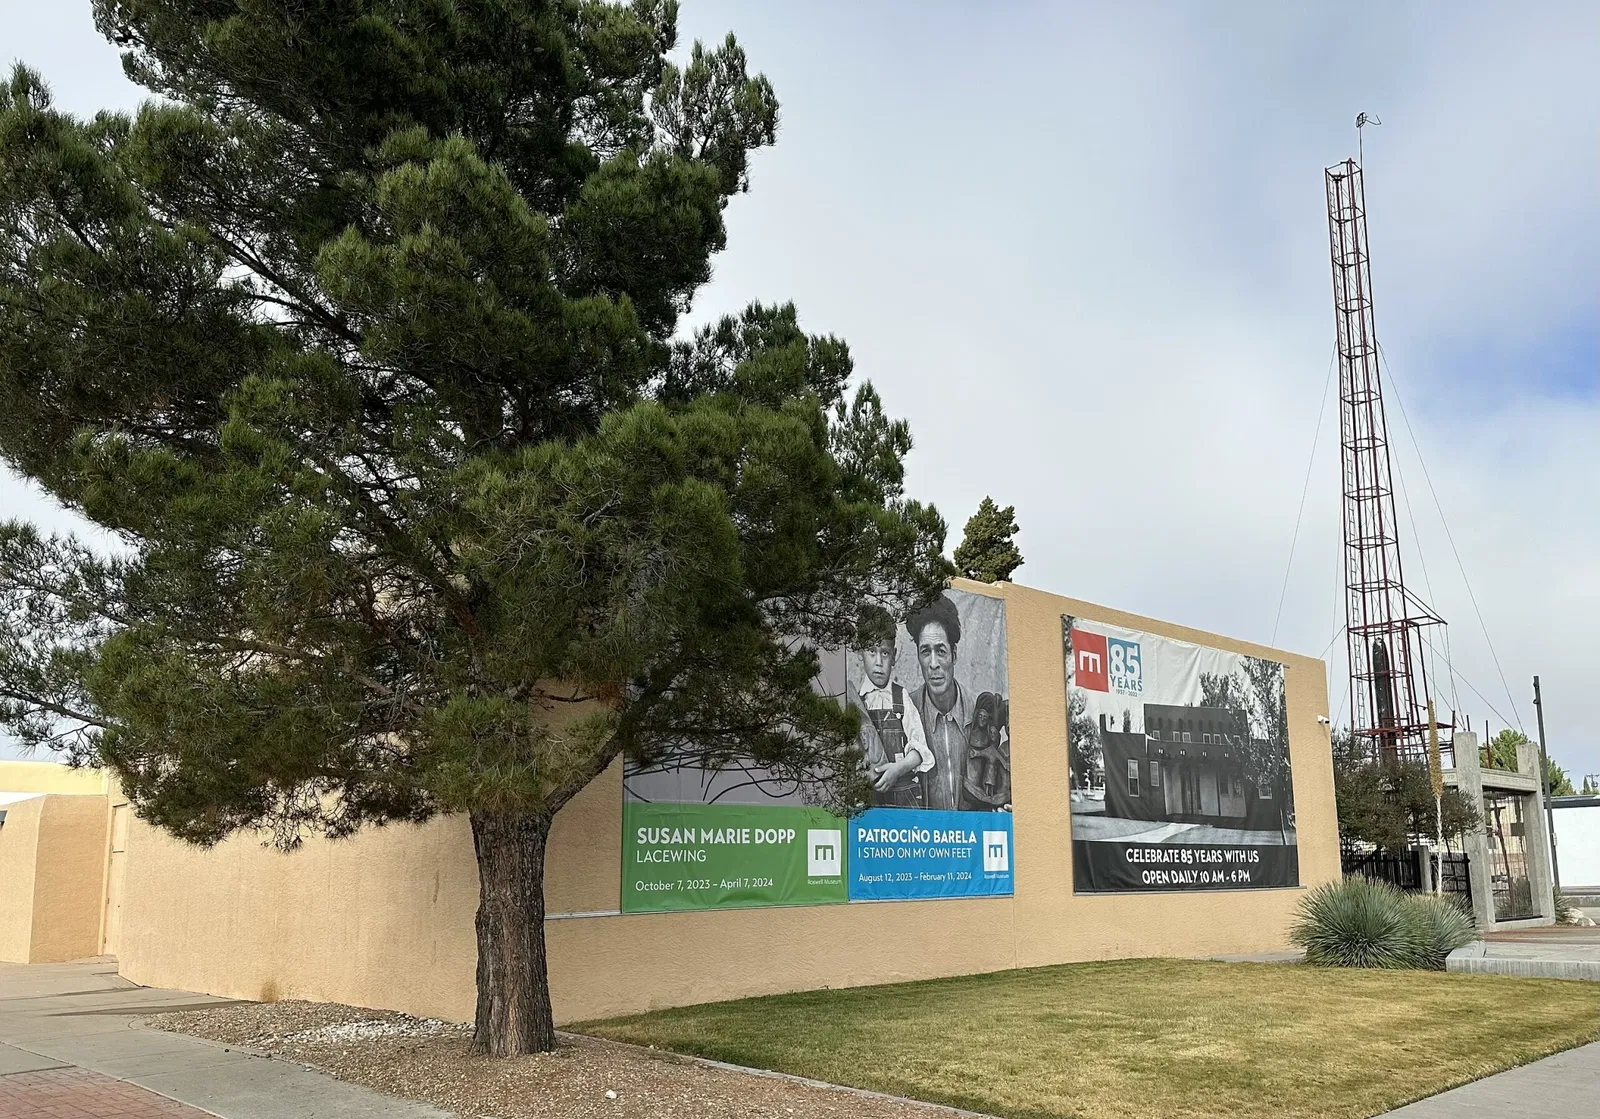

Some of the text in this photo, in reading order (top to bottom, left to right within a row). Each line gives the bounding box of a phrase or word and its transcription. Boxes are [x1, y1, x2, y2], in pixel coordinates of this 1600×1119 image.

[1110, 644, 1140, 679] 85
[1110, 675, 1142, 692] YEARS
[636, 827, 796, 844] SUSAN MARIE DOPP
[858, 826, 977, 844] PATROCIÑO BARELA
[636, 849, 707, 863] LACEWING
[858, 847, 972, 859] I STAND ON MY OWN FEET
[1126, 848, 1259, 864] CELEBRATE 85 YEARS WITH US
[635, 880, 675, 892] October
[677, 881, 684, 892] 7,
[687, 879, 710, 890] 2023
[720, 878, 742, 890] April
[744, 878, 751, 889] 7,
[752, 877, 773, 887] 2024
[859, 873, 883, 884] August
[884, 873, 893, 883] 12,
[895, 873, 913, 882] 2023
[920, 872, 946, 883] February
[947, 872, 955, 882] 11,
[956, 872, 972, 880] 2024
[1142, 870, 1169, 885] OPEN
[1171, 870, 1198, 884] DAILY
[1199, 870, 1209, 883] 10
[1211, 870, 1225, 883] AM
[1231, 870, 1237, 883] 6
[1238, 869, 1251, 883] PM
